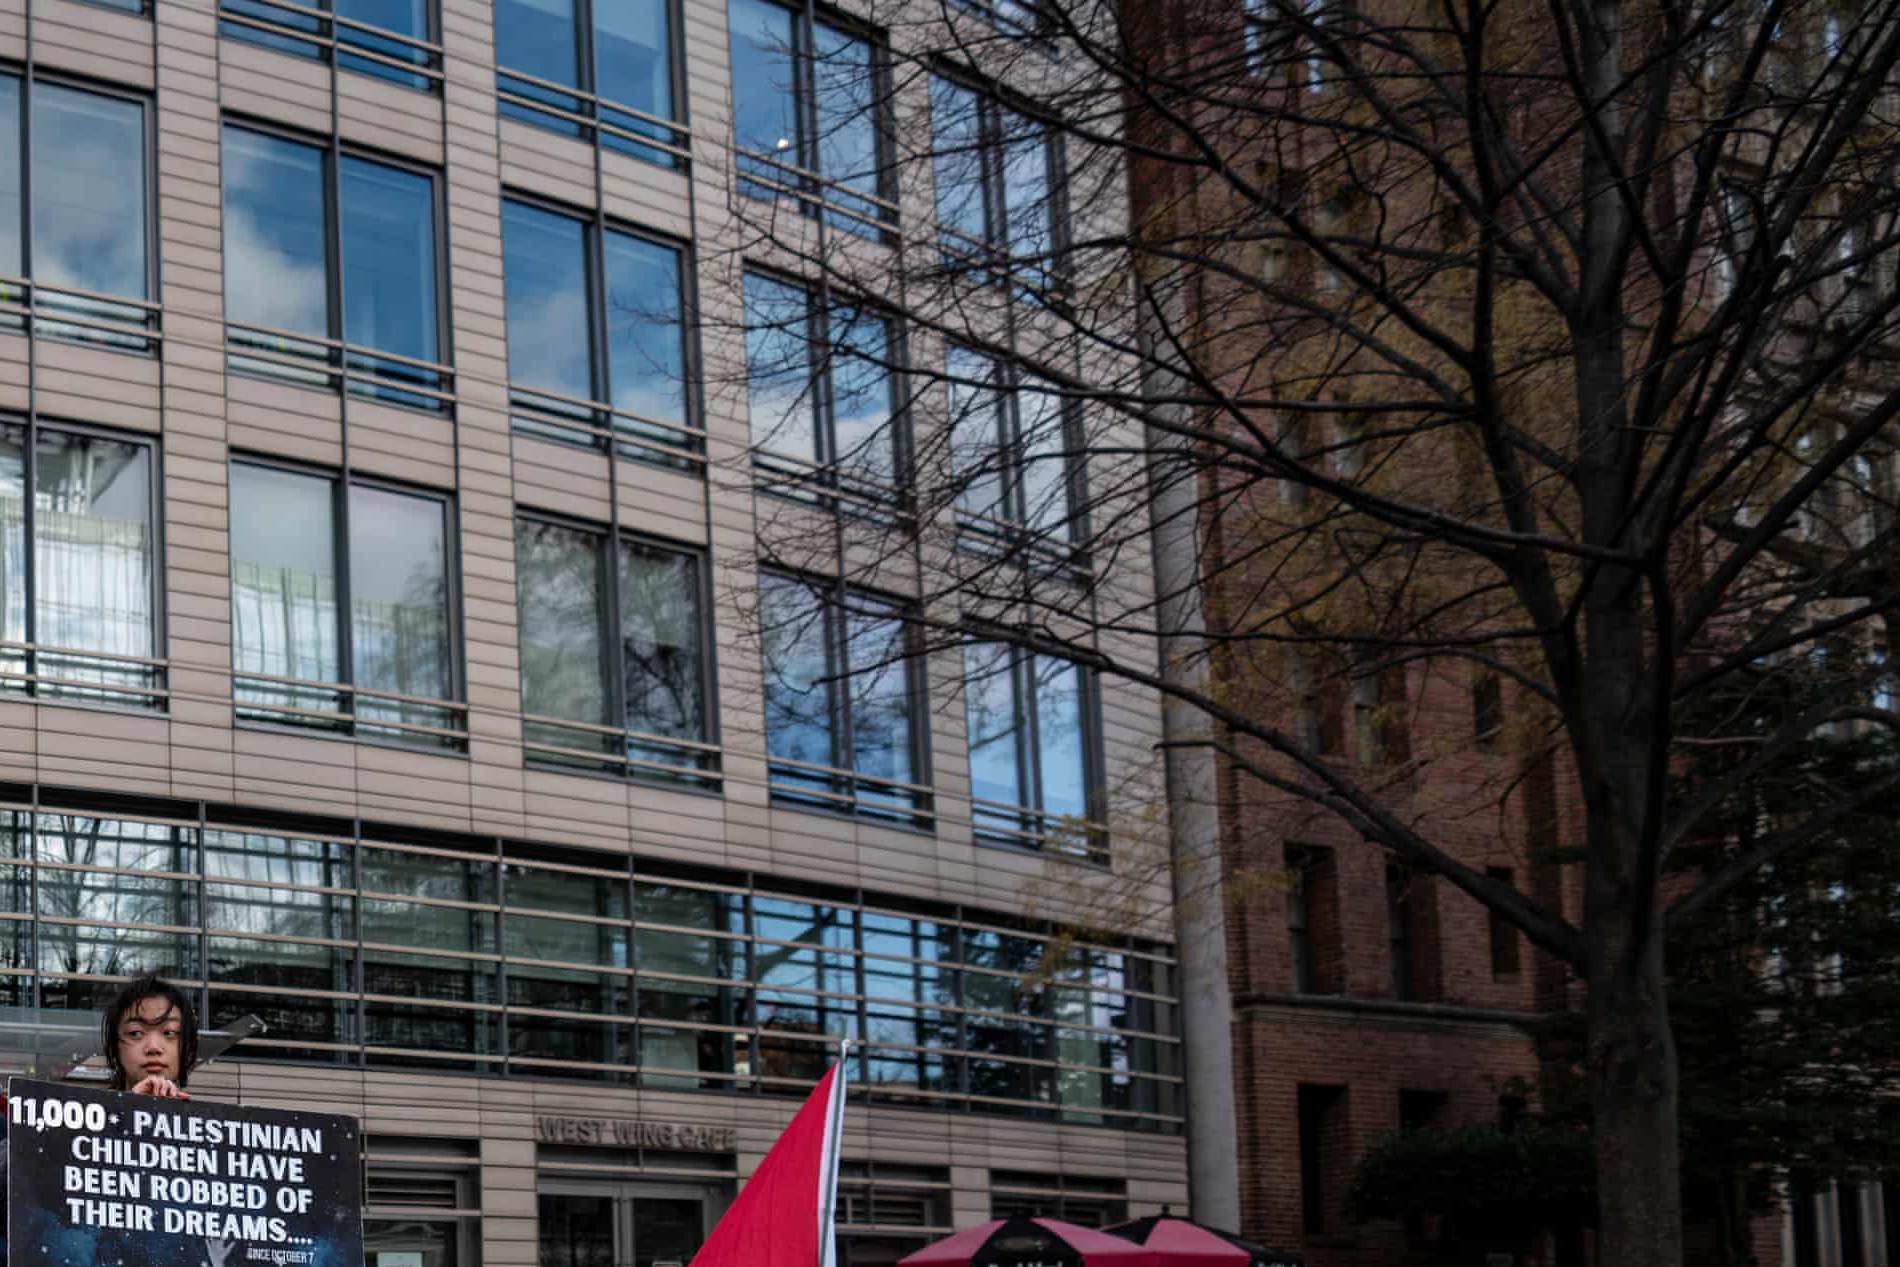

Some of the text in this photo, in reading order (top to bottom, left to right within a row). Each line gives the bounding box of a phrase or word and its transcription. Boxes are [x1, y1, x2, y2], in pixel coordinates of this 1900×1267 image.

[133, 1110, 322, 1153] PALESTINIAN
[538, 1116, 605, 1144] WEST
[612, 1120, 673, 1147] WING
[71, 1136, 305, 1182] CHILDREN HAVE
[64, 1165, 313, 1214] BEEN ROBBED OF
[66, 1198, 154, 1231] THEIR
